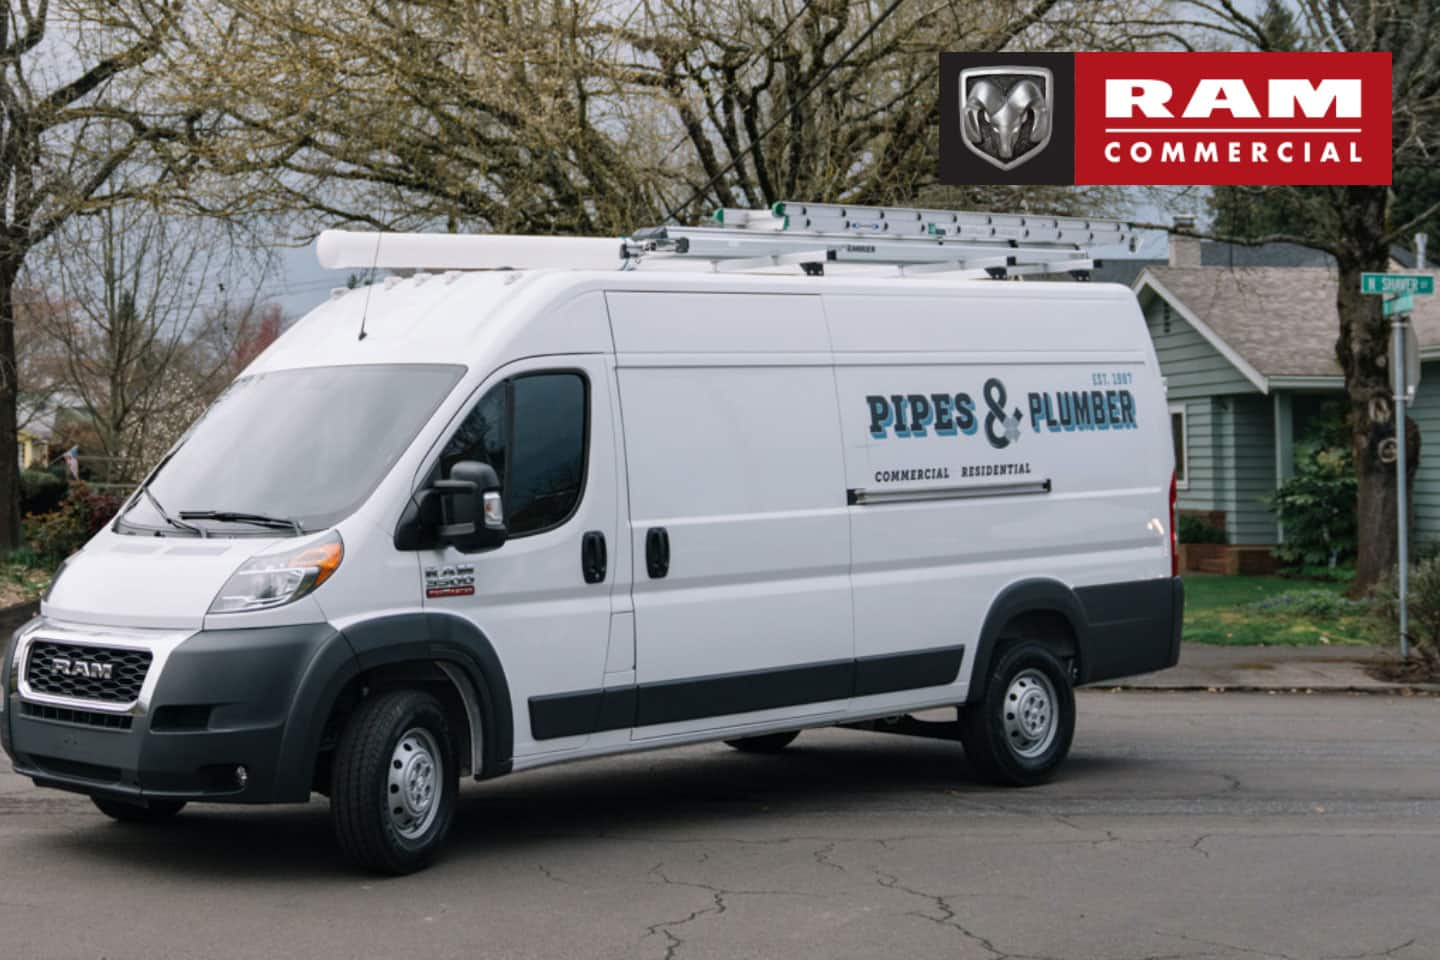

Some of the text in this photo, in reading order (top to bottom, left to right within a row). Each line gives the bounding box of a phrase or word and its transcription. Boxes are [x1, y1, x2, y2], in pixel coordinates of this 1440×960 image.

[1368, 277, 1375, 291] N
[1091, 373, 1110, 386] EST.
[866, 378, 1139, 450] PIPES & PLUMBER
[875, 463, 1032, 482] COMMERCIAL RESIDENTIAL
[51, 658, 113, 680] RAM
